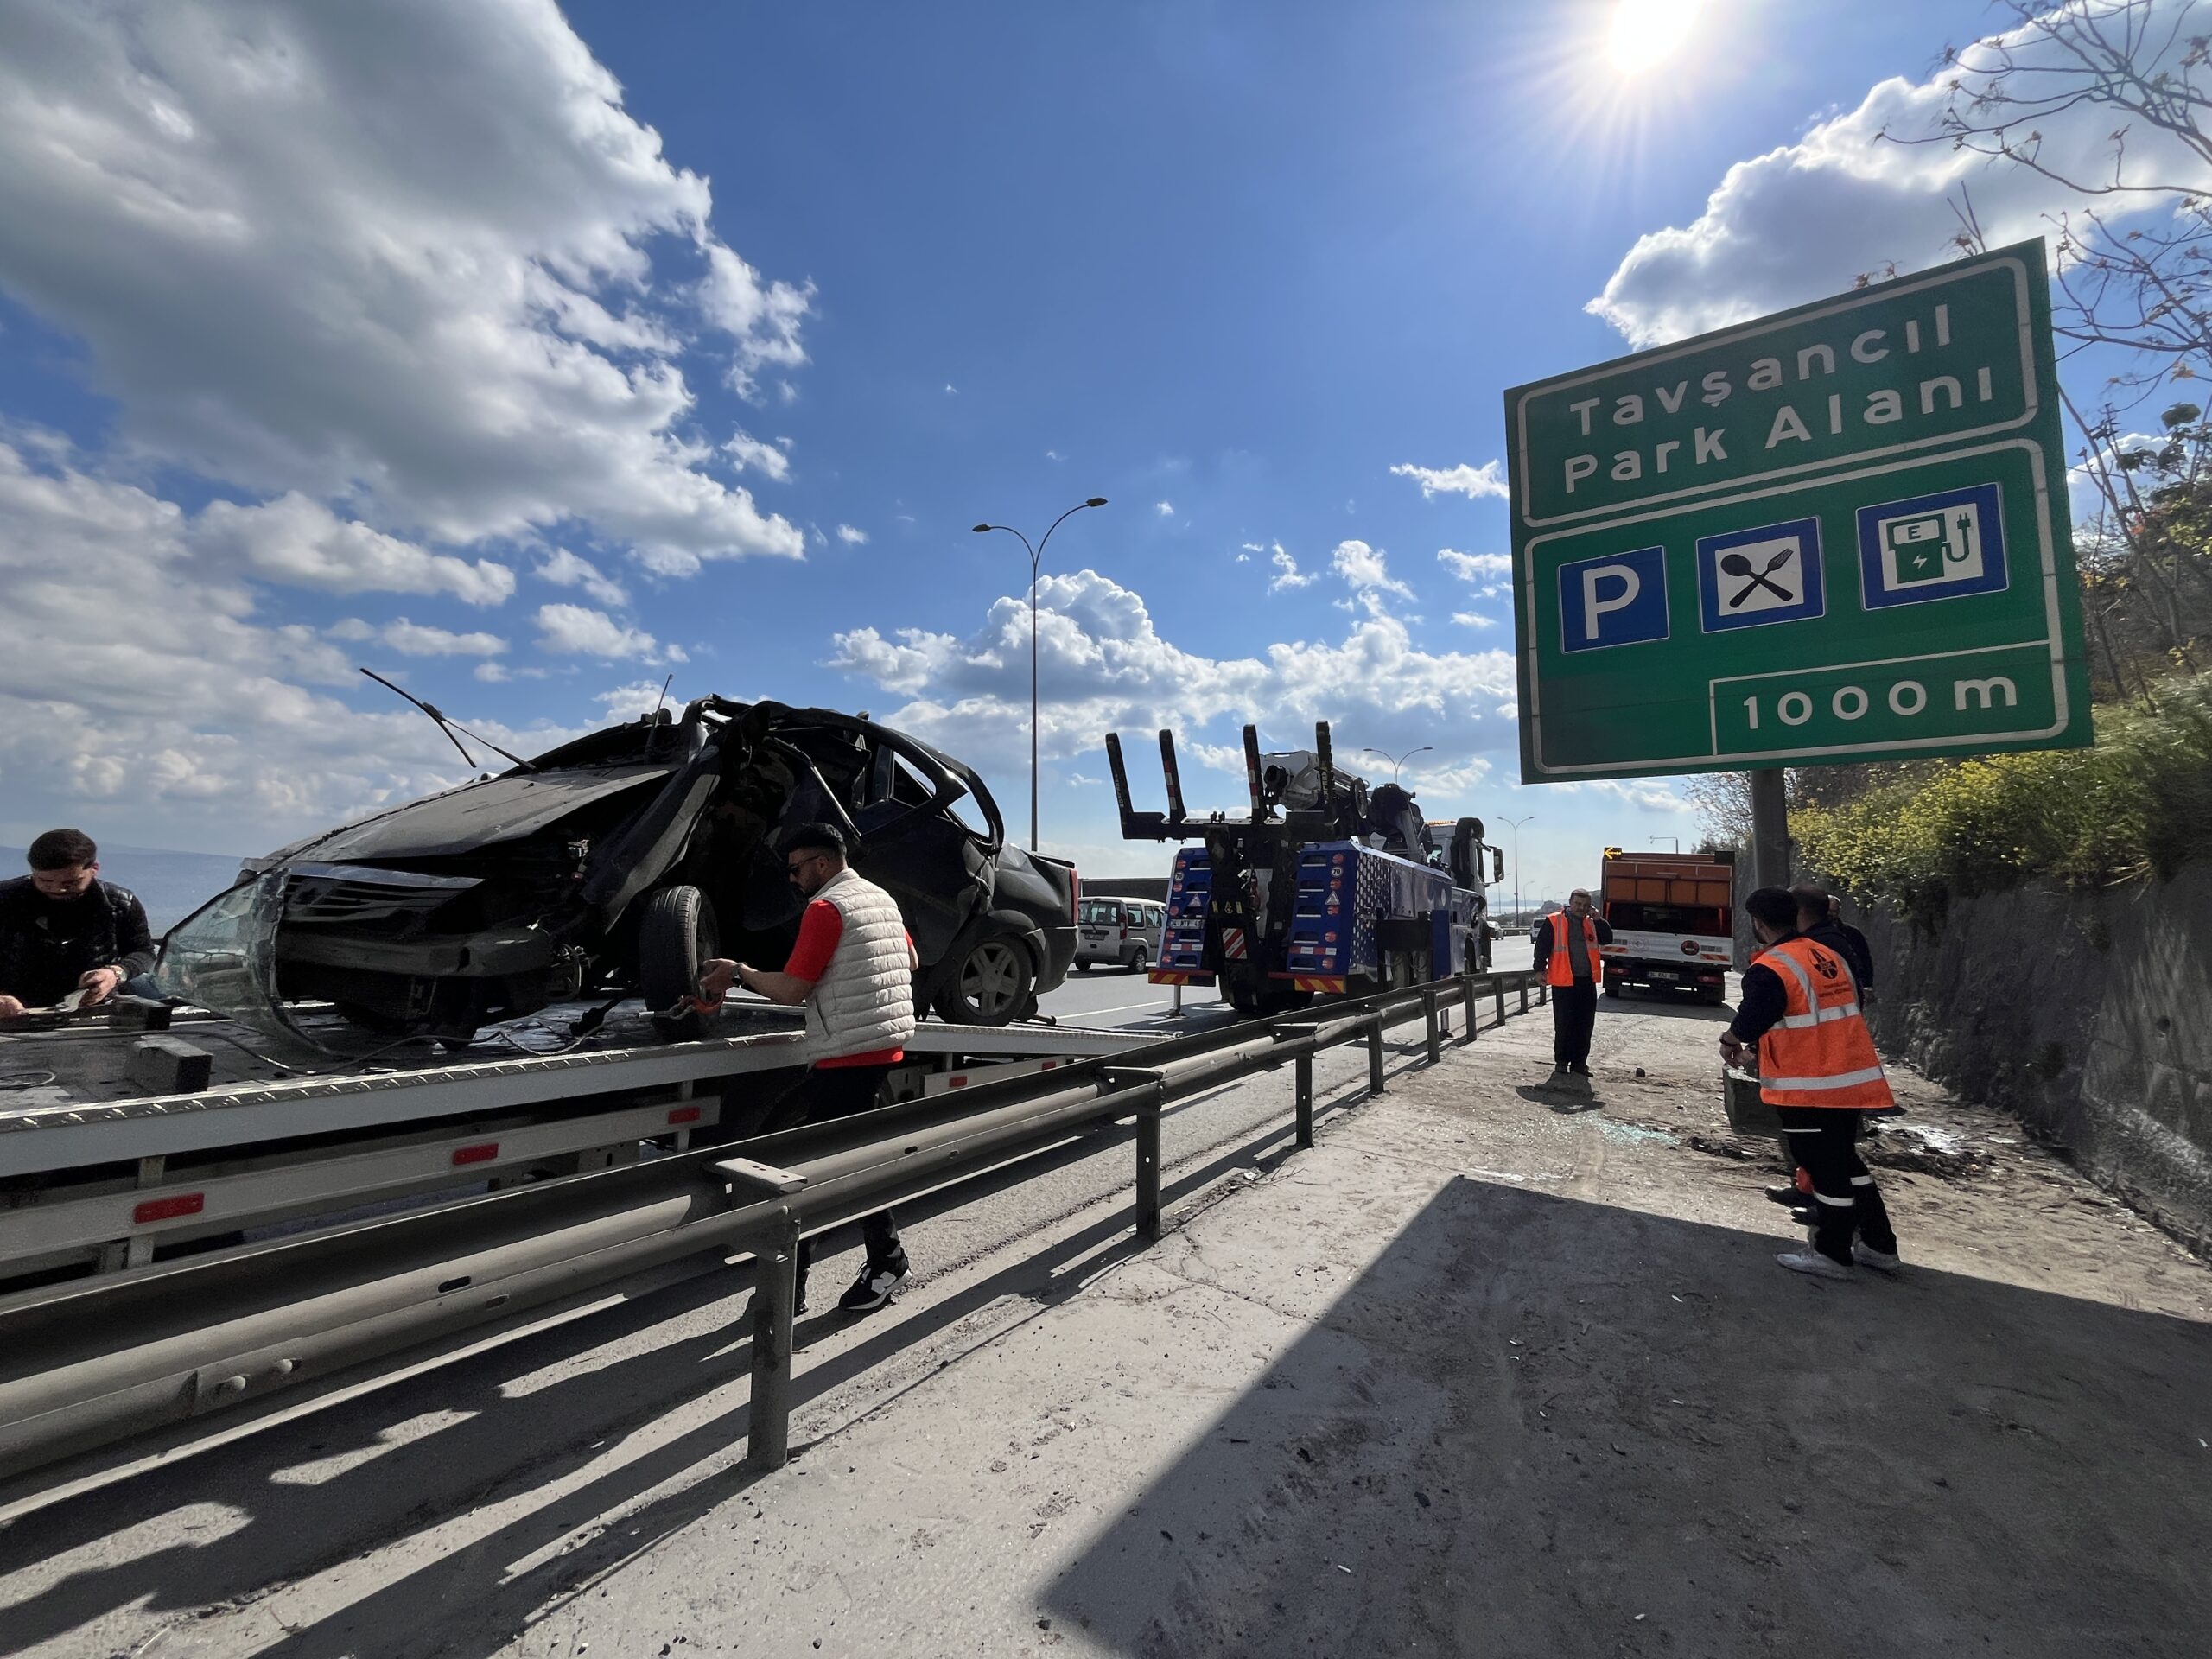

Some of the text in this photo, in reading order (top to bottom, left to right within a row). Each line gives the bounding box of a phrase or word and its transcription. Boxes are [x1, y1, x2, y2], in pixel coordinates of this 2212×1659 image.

[1569, 304, 1950, 436] Tavşancıl
[1565, 366, 1993, 493] Park Alanı
[1908, 525, 1921, 540] E
[1582, 565, 1641, 639] P
[1744, 677, 2017, 729] 1000 m
